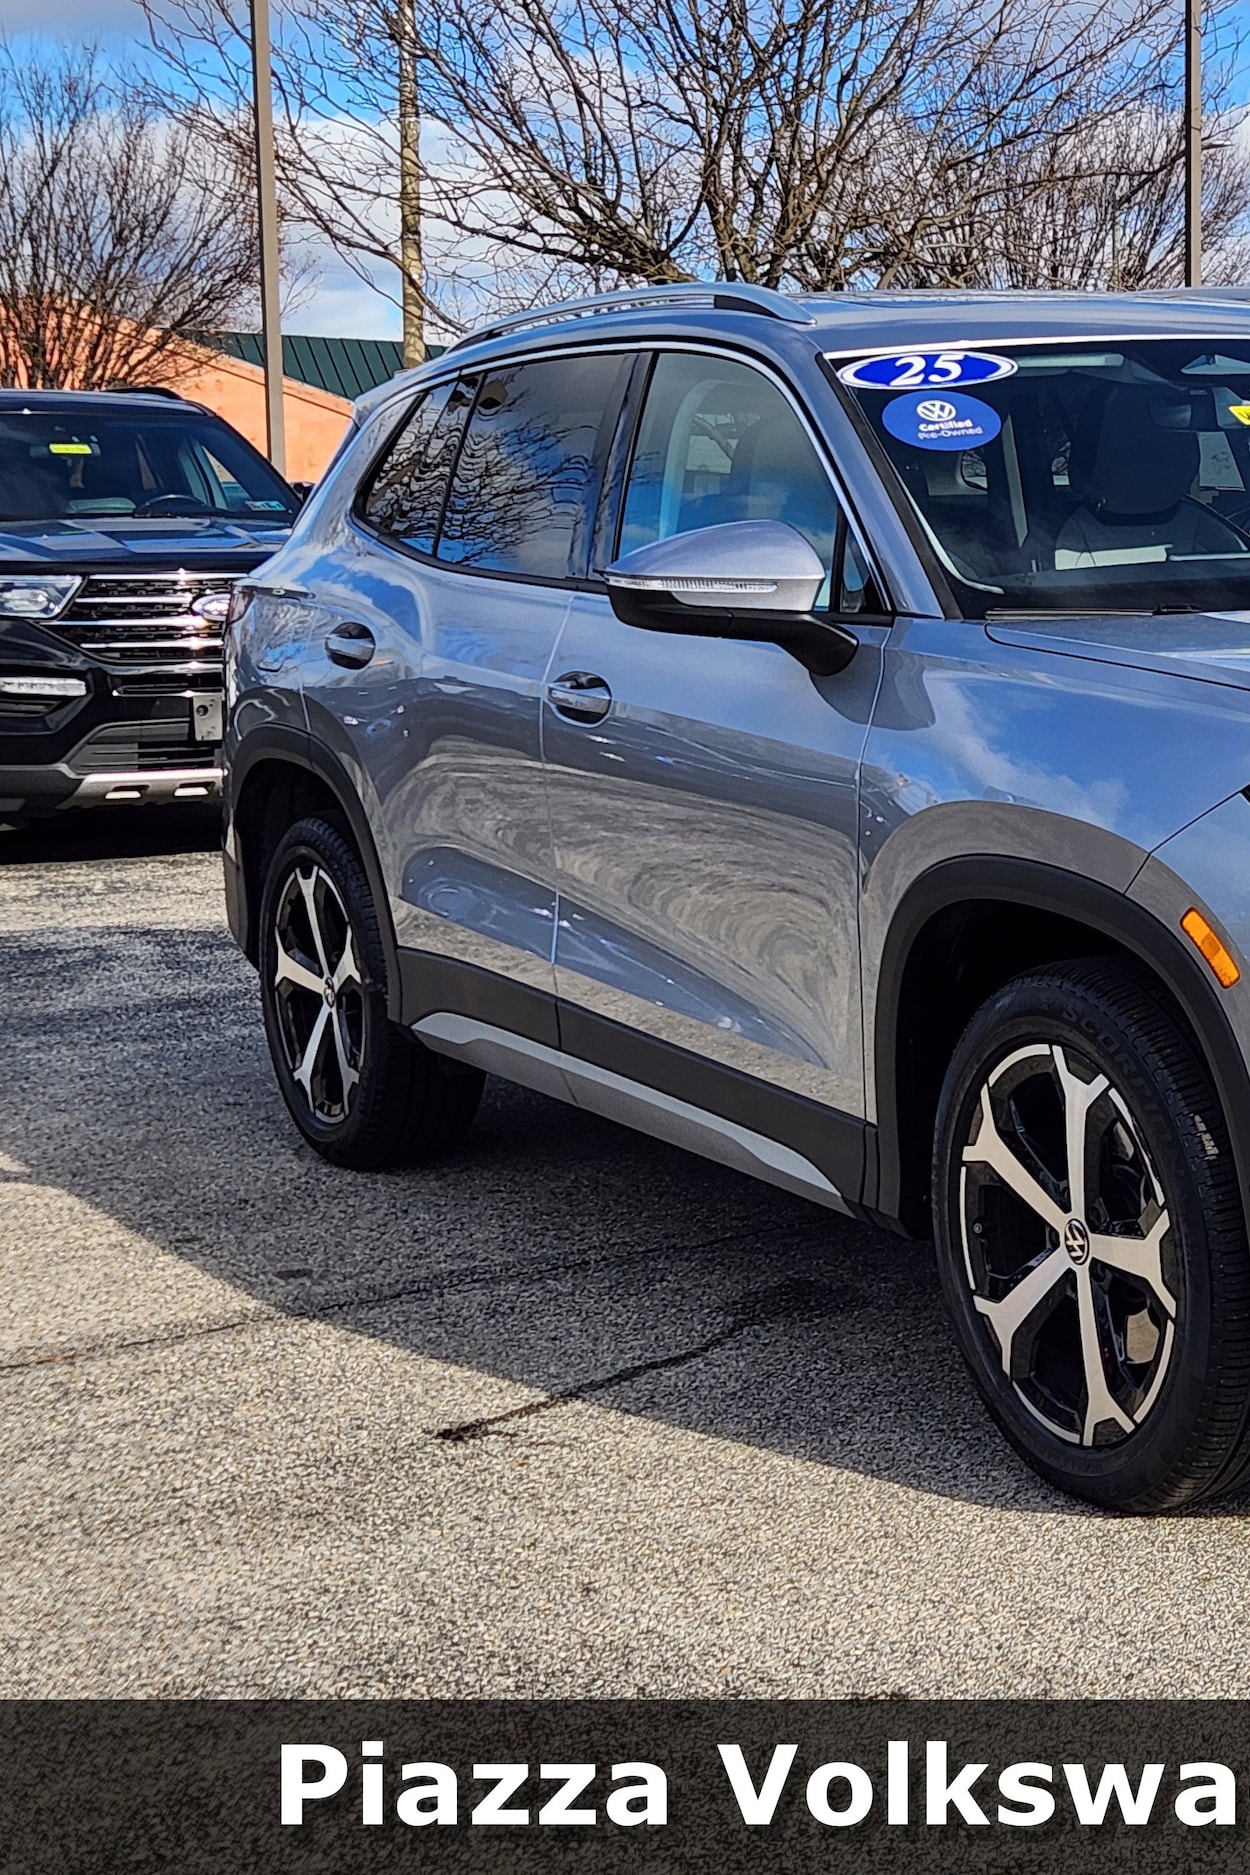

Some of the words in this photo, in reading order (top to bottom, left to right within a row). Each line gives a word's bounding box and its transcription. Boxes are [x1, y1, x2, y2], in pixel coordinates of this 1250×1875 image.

[889, 354, 965, 386] 25
[918, 418, 973, 432] Certified
[917, 426, 984, 440] Pre-Owned
